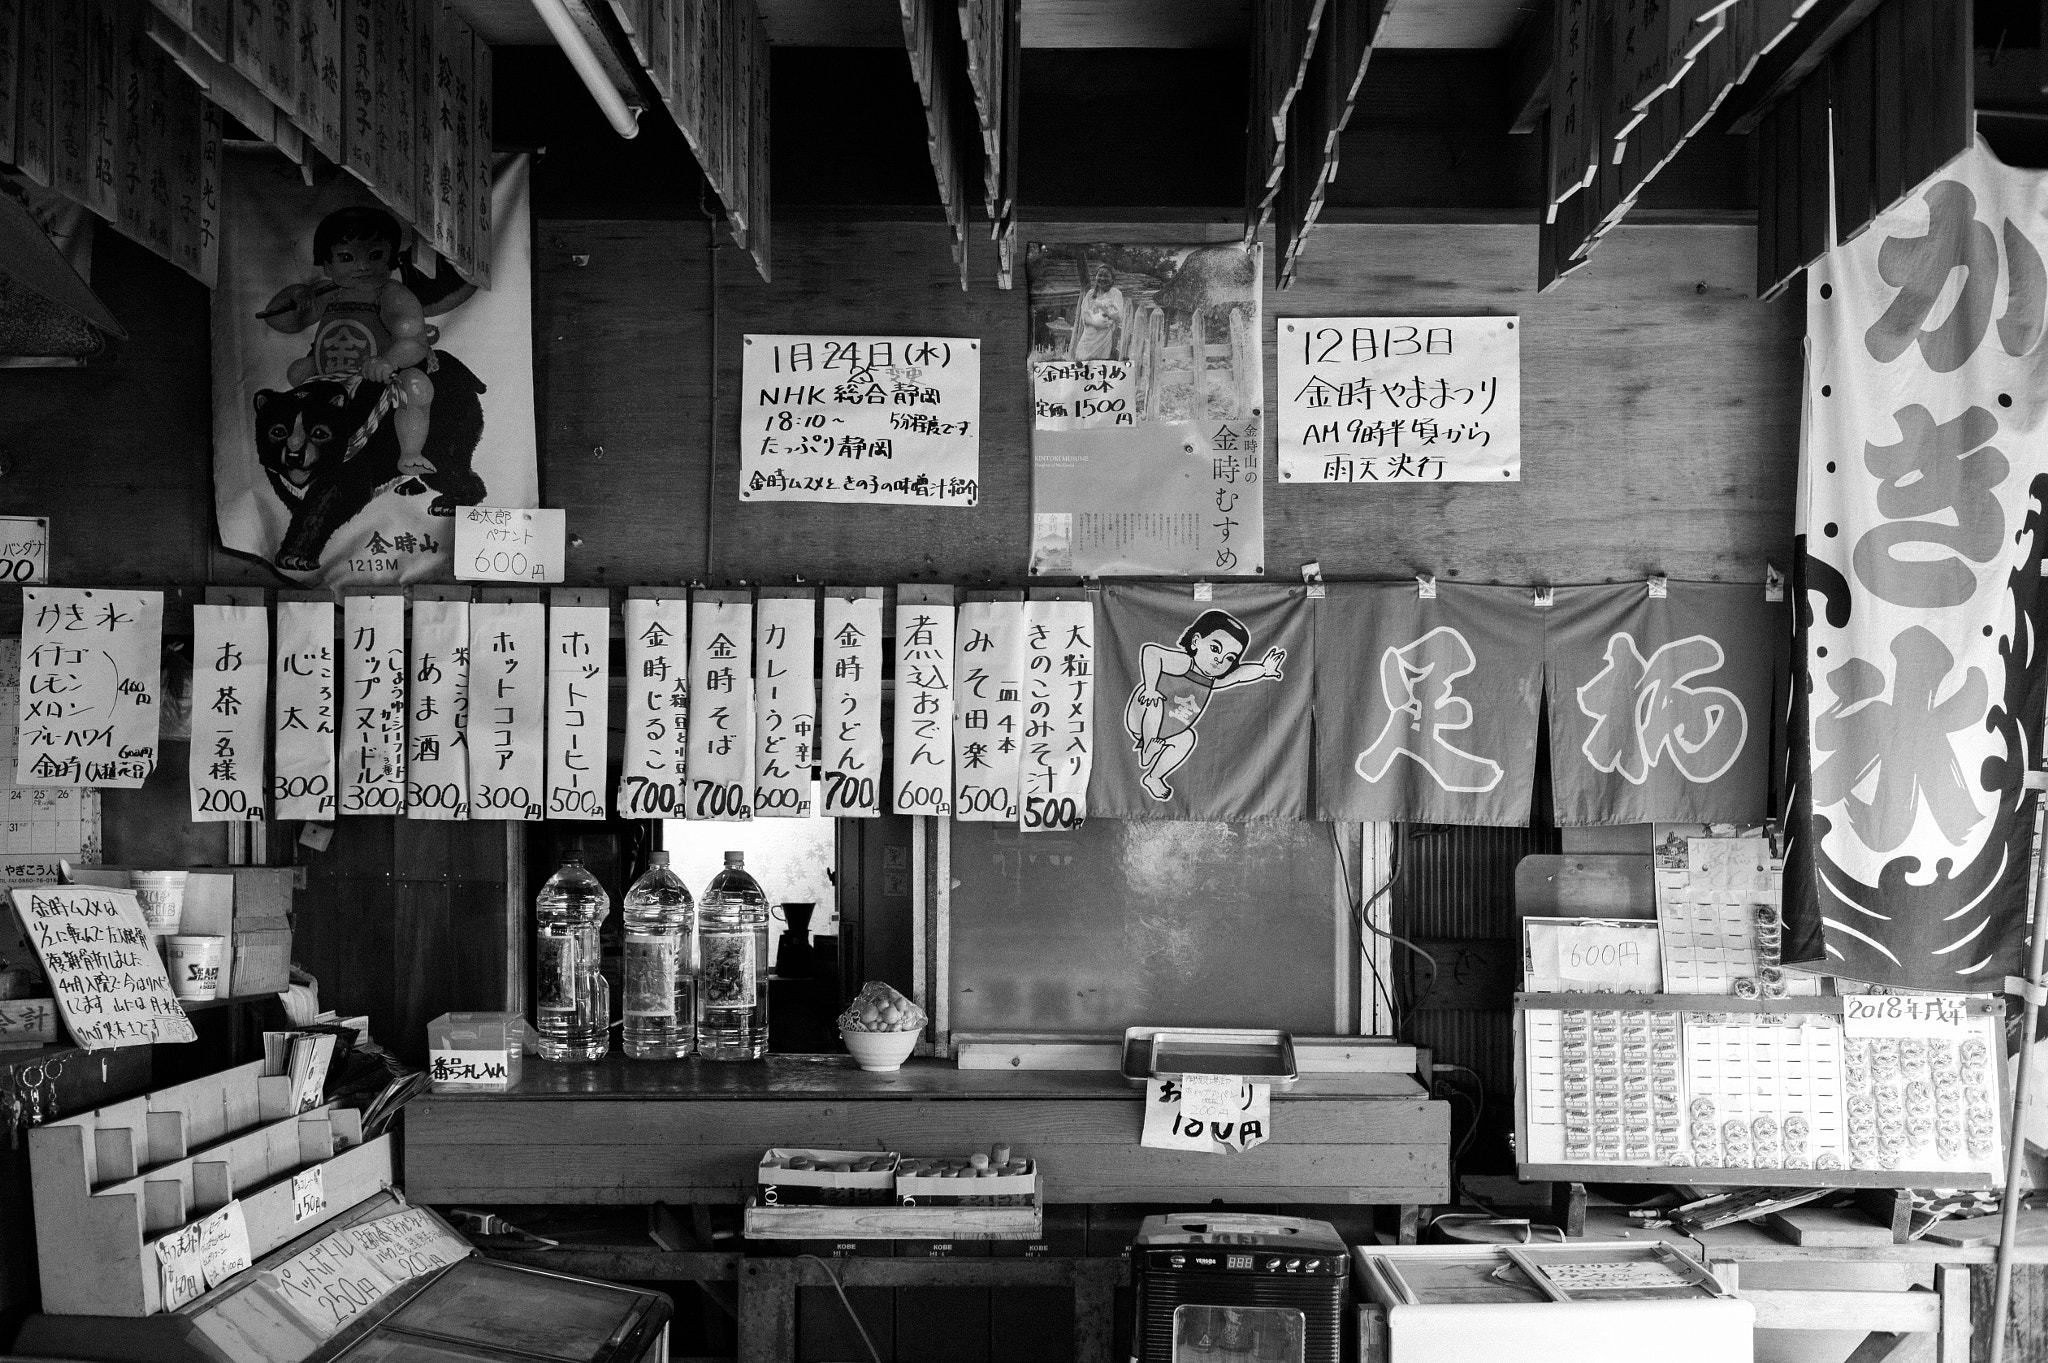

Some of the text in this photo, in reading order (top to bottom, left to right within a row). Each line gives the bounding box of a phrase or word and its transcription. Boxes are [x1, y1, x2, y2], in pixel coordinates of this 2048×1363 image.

[1305, 326, 1453, 366] 12月13日
[1037, 364, 1131, 385] 金時むすめ
[760, 382, 941, 407] NHK 総合静岡
[1294, 374, 1497, 415] 金時やままつり
[761, 435, 893, 460] たっぷり静岡
[1244, 424, 1258, 484] 金時山の
[1324, 453, 1448, 483] 雨天決行
[1211, 424, 1240, 571] 金時むすめ
[467, 509, 513, 525] 金太郎
[1812, 179, 2048, 853] かき氷
[366, 531, 440, 555] 金時山
[485, 528, 535, 545] ペナント
[348, 557, 399, 573] 1213M
[474, 552, 546, 581] 600円
[35, 602, 134, 634] かき氷
[27, 641, 90, 668] イチゴ
[29, 674, 83, 694] レモン
[317, 647, 334, 733] ところてん
[493, 631, 520, 771] ホットココア
[639, 621, 674, 770] 金時じるこ
[706, 632, 738, 756] 金時そば
[762, 623, 790, 779] カレーうどん
[833, 622, 866, 771] 金時うどん
[903, 614, 949, 766] 煮込おでん
[962, 628, 995, 769] みそ田楽
[1061, 624, 1093, 776] 大粒ナメコ入り
[24, 700, 95, 721] メロン
[353, 626, 384, 784] カップヌードル
[411, 652, 442, 762] あま酒
[561, 631, 600, 788] ホットコーヒー
[1025, 624, 1058, 794] きのこのみそ汁
[23, 725, 115, 748] ブルーハワイ
[10, 789, 69, 800] 24 25 26
[198, 787, 264, 820] 200円
[475, 784, 542, 820] 300円
[549, 786, 605, 818] 500円
[626, 775, 687, 818] 700円
[694, 779, 752, 820] 700円
[753, 786, 812, 815] 600円
[897, 780, 951, 815] 600円
[8, 822, 19, 832] 31
[1023, 796, 1084, 830] 500円
[31, 894, 118, 918] 金時ムスメは
[1570, 941, 1641, 968] 600円
[318, 1277, 382, 1327] 250円
